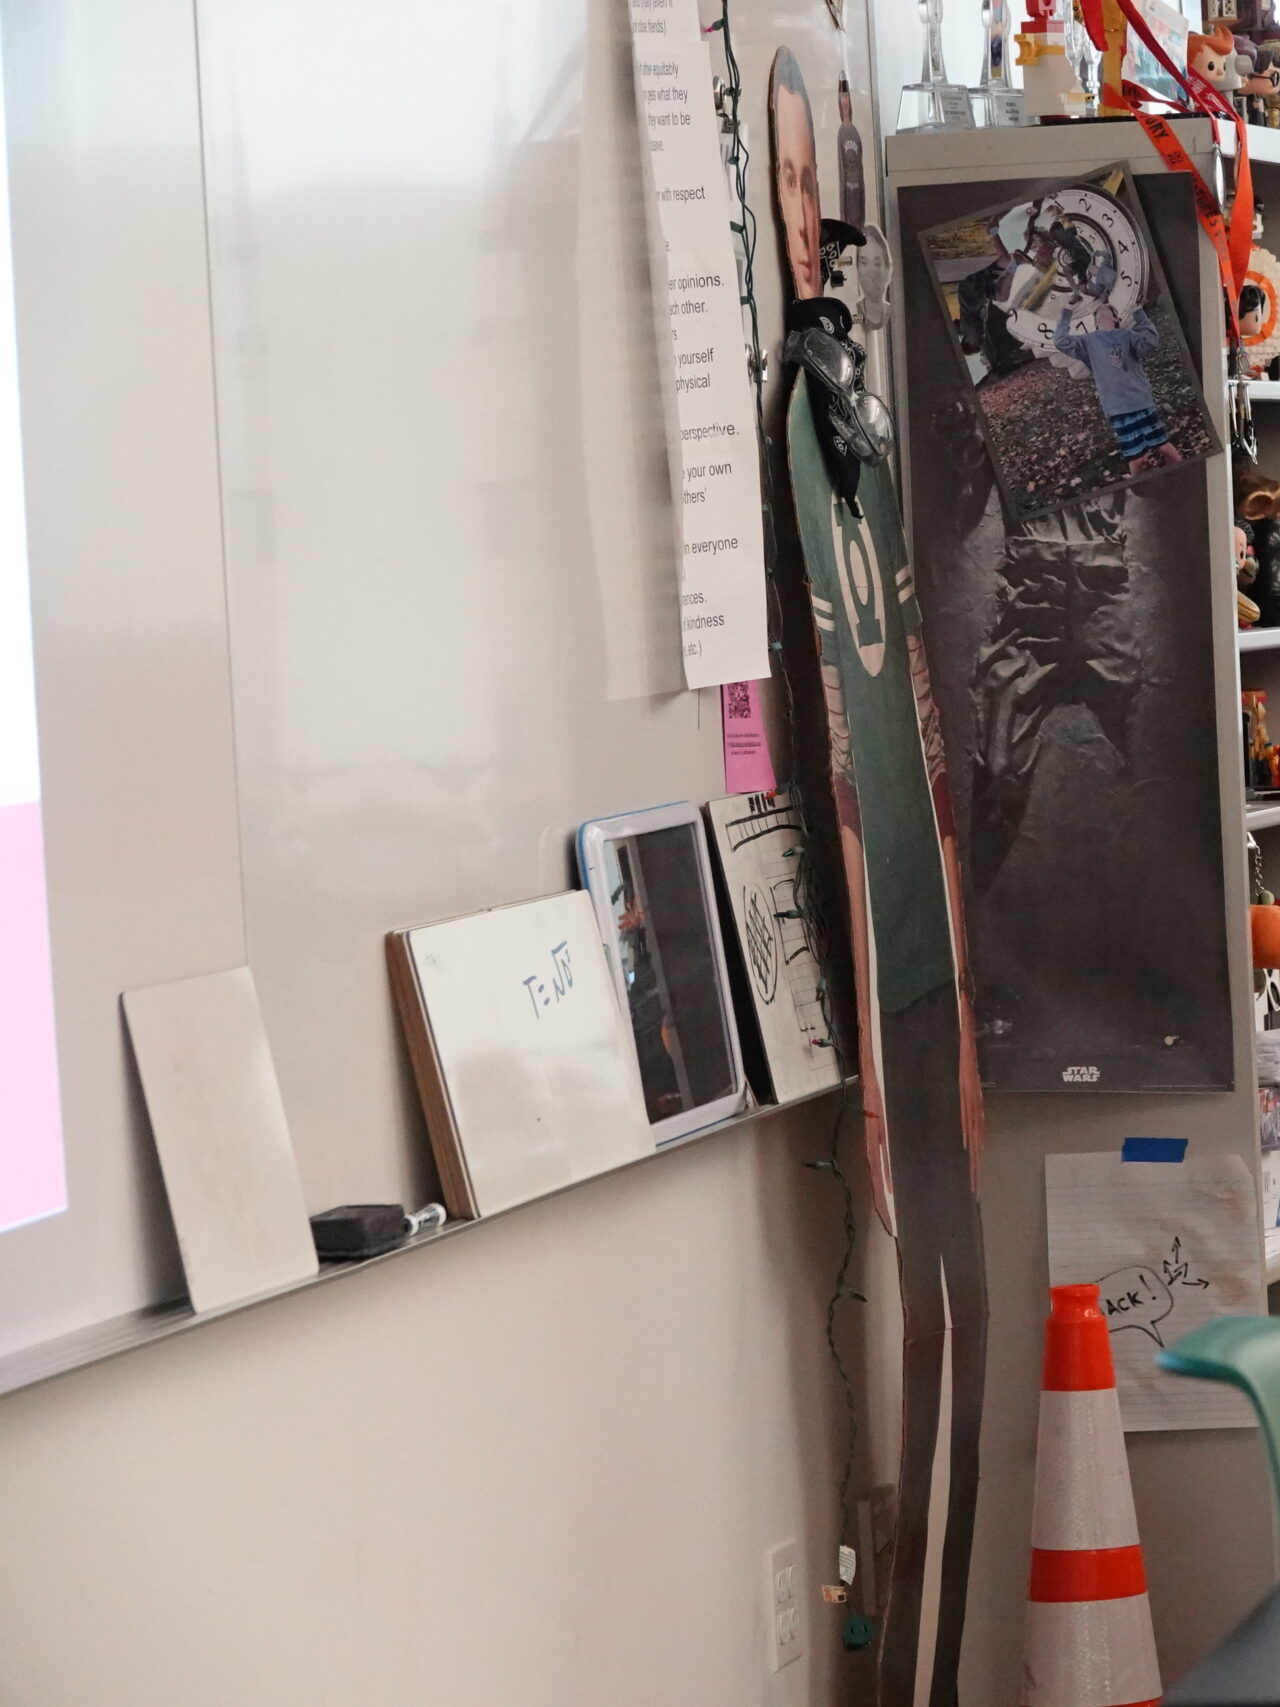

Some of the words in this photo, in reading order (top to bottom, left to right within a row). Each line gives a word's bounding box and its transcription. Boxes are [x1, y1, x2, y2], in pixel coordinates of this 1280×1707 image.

[653, 62, 679, 79] equitably
[658, 88, 671, 101] what
[672, 87, 688, 104] they
[657, 112, 670, 126] want
[672, 112, 679, 126] to
[680, 111, 691, 126] be
[673, 185, 706, 204] respect
[1078, 197, 1092, 212] 2
[1101, 212, 1114, 228] 3
[1117, 239, 1129, 255] 4
[677, 272, 726, 293] opinions.
[1120, 270, 1133, 288] 5
[680, 300, 709, 315] other.
[1037, 322, 1055, 340] 8
[678, 346, 714, 369] yourself
[675, 373, 711, 393] physical
[687, 465, 706, 483] your
[709, 463, 732, 477] own
[683, 487, 707, 505] thers'
[691, 537, 738, 555] everyone
[686, 614, 725, 630] kindness
[1062, 1066, 1101, 1075] STAR
[1062, 1074, 1101, 1082] WARS
[1100, 1274, 1157, 1316] ACK!
